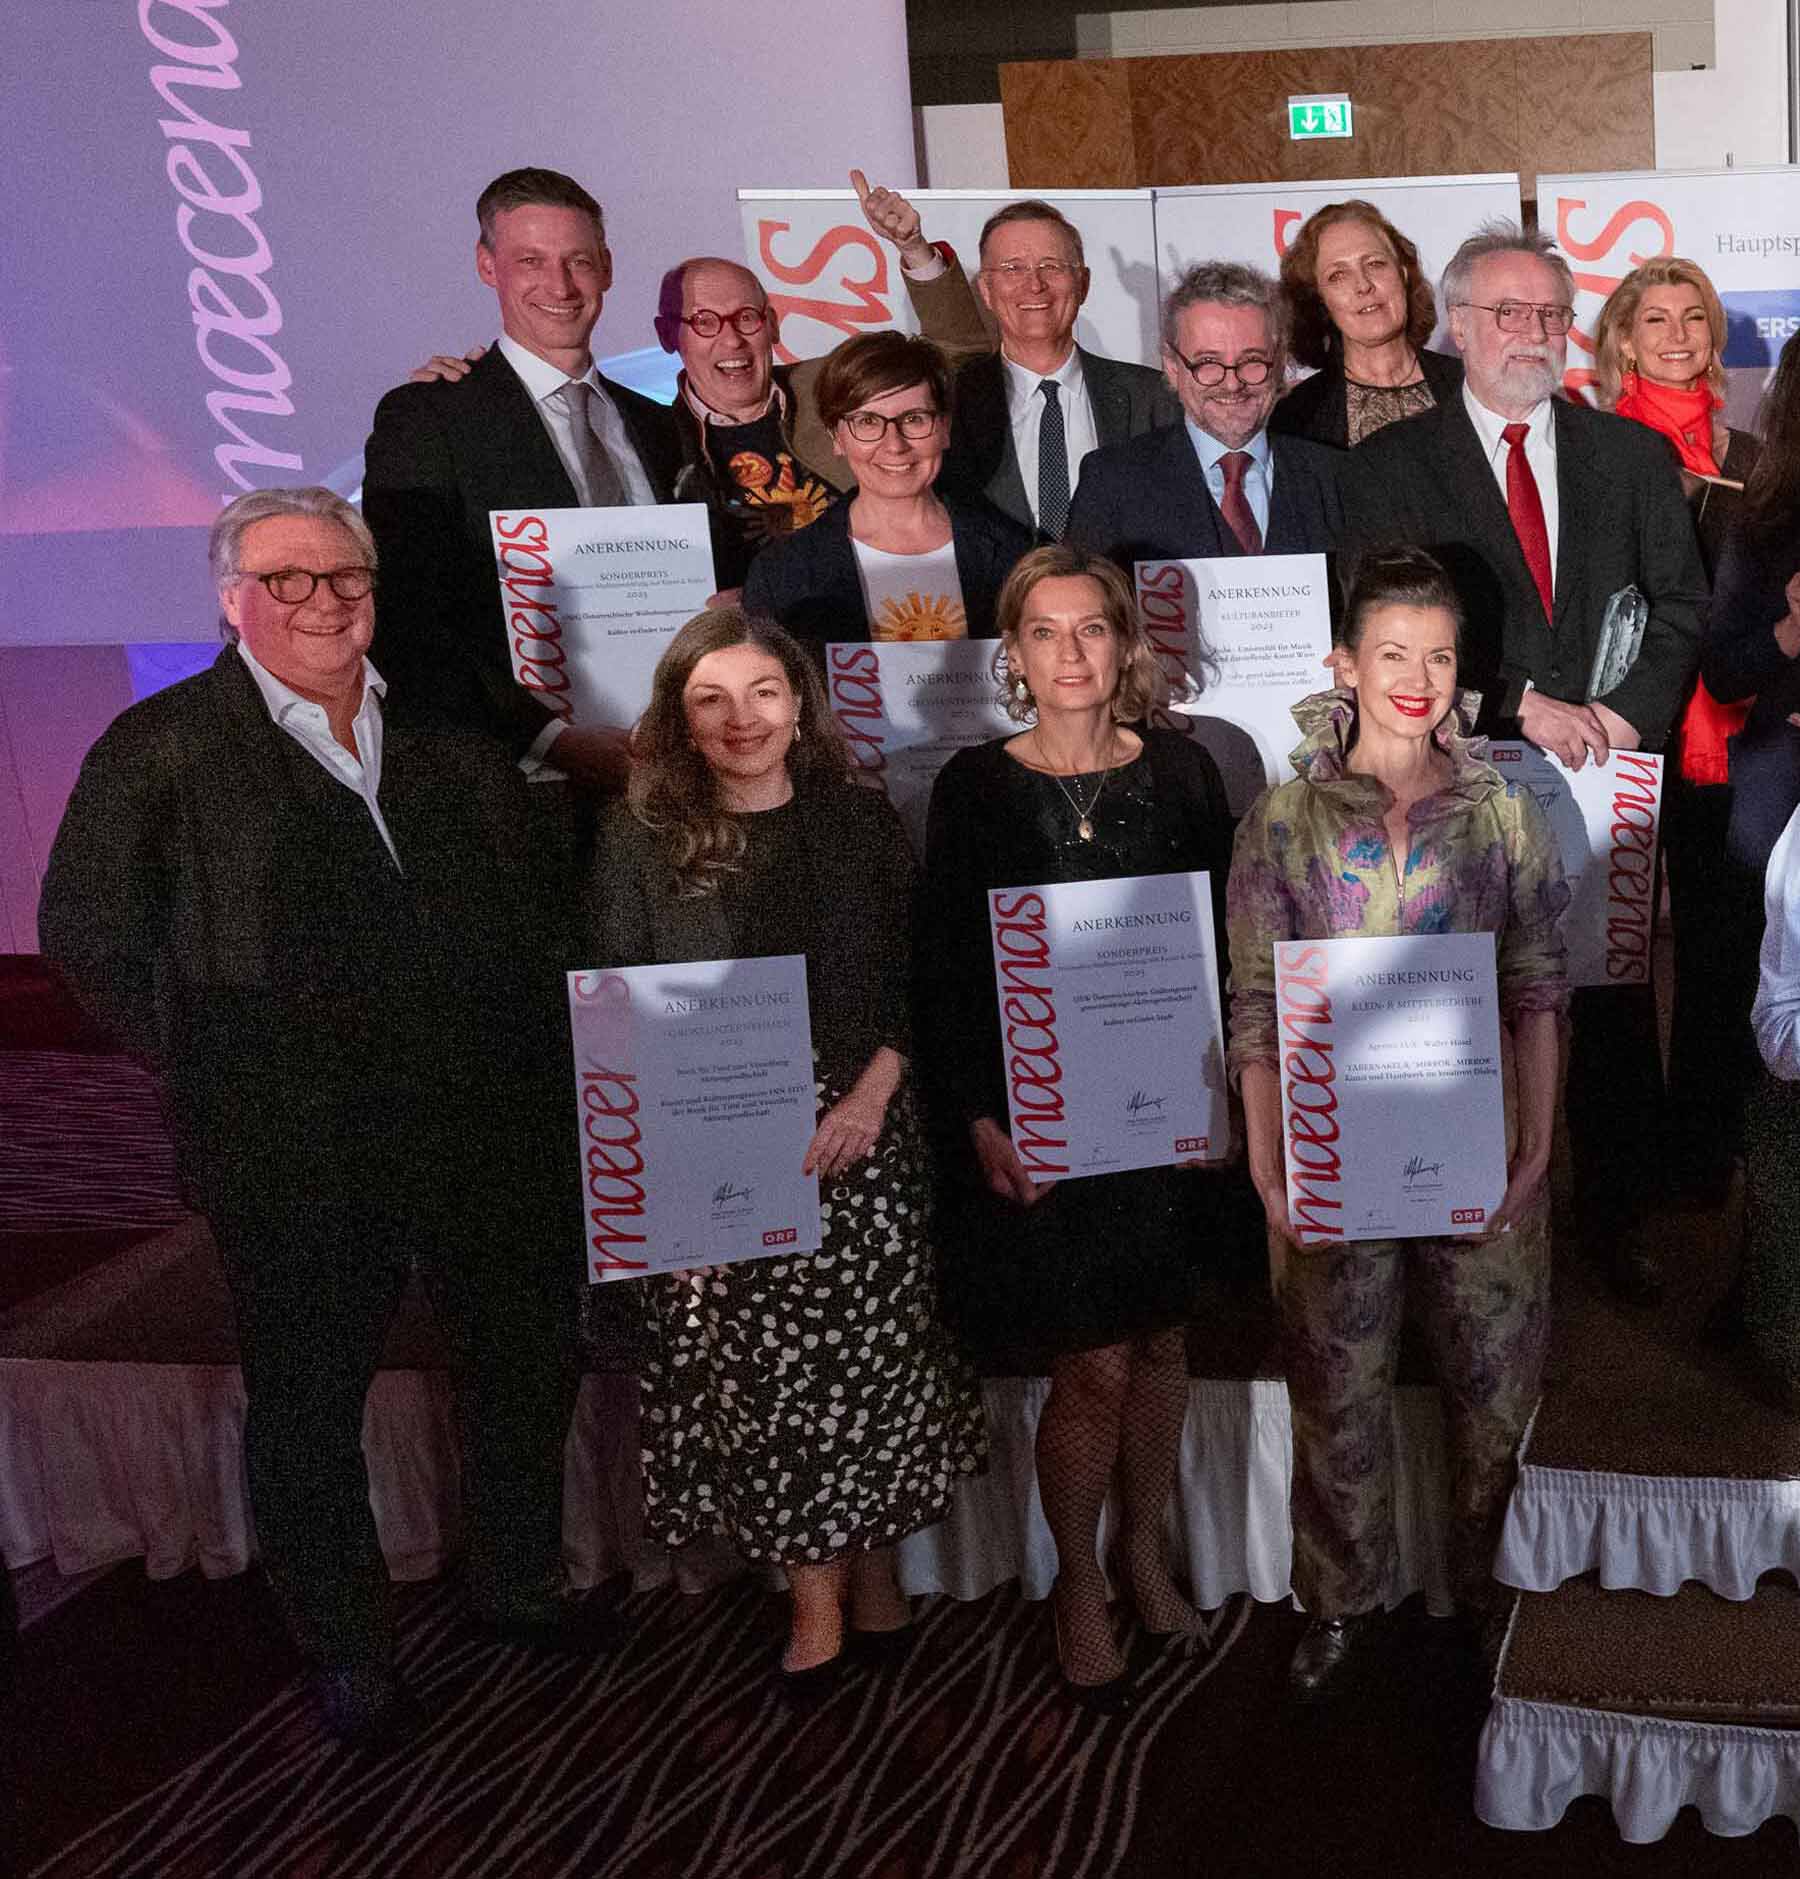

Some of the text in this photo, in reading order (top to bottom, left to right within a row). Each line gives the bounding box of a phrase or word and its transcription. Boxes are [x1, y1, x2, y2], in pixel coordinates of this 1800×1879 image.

[575, 538, 689, 555] ANERKENNUNG
[1208, 585, 1311, 601] ANERKENNUNG
[1073, 911, 1192, 933] ANERKENNUNG
[1356, 969, 1474, 986] ANERKENNUNG
[665, 991, 791, 1014] ANERKENNUNG
[1177, 1141, 1206, 1151] ORF
[1454, 1210, 1483, 1222] ORF
[765, 1231, 796, 1243] ORF
